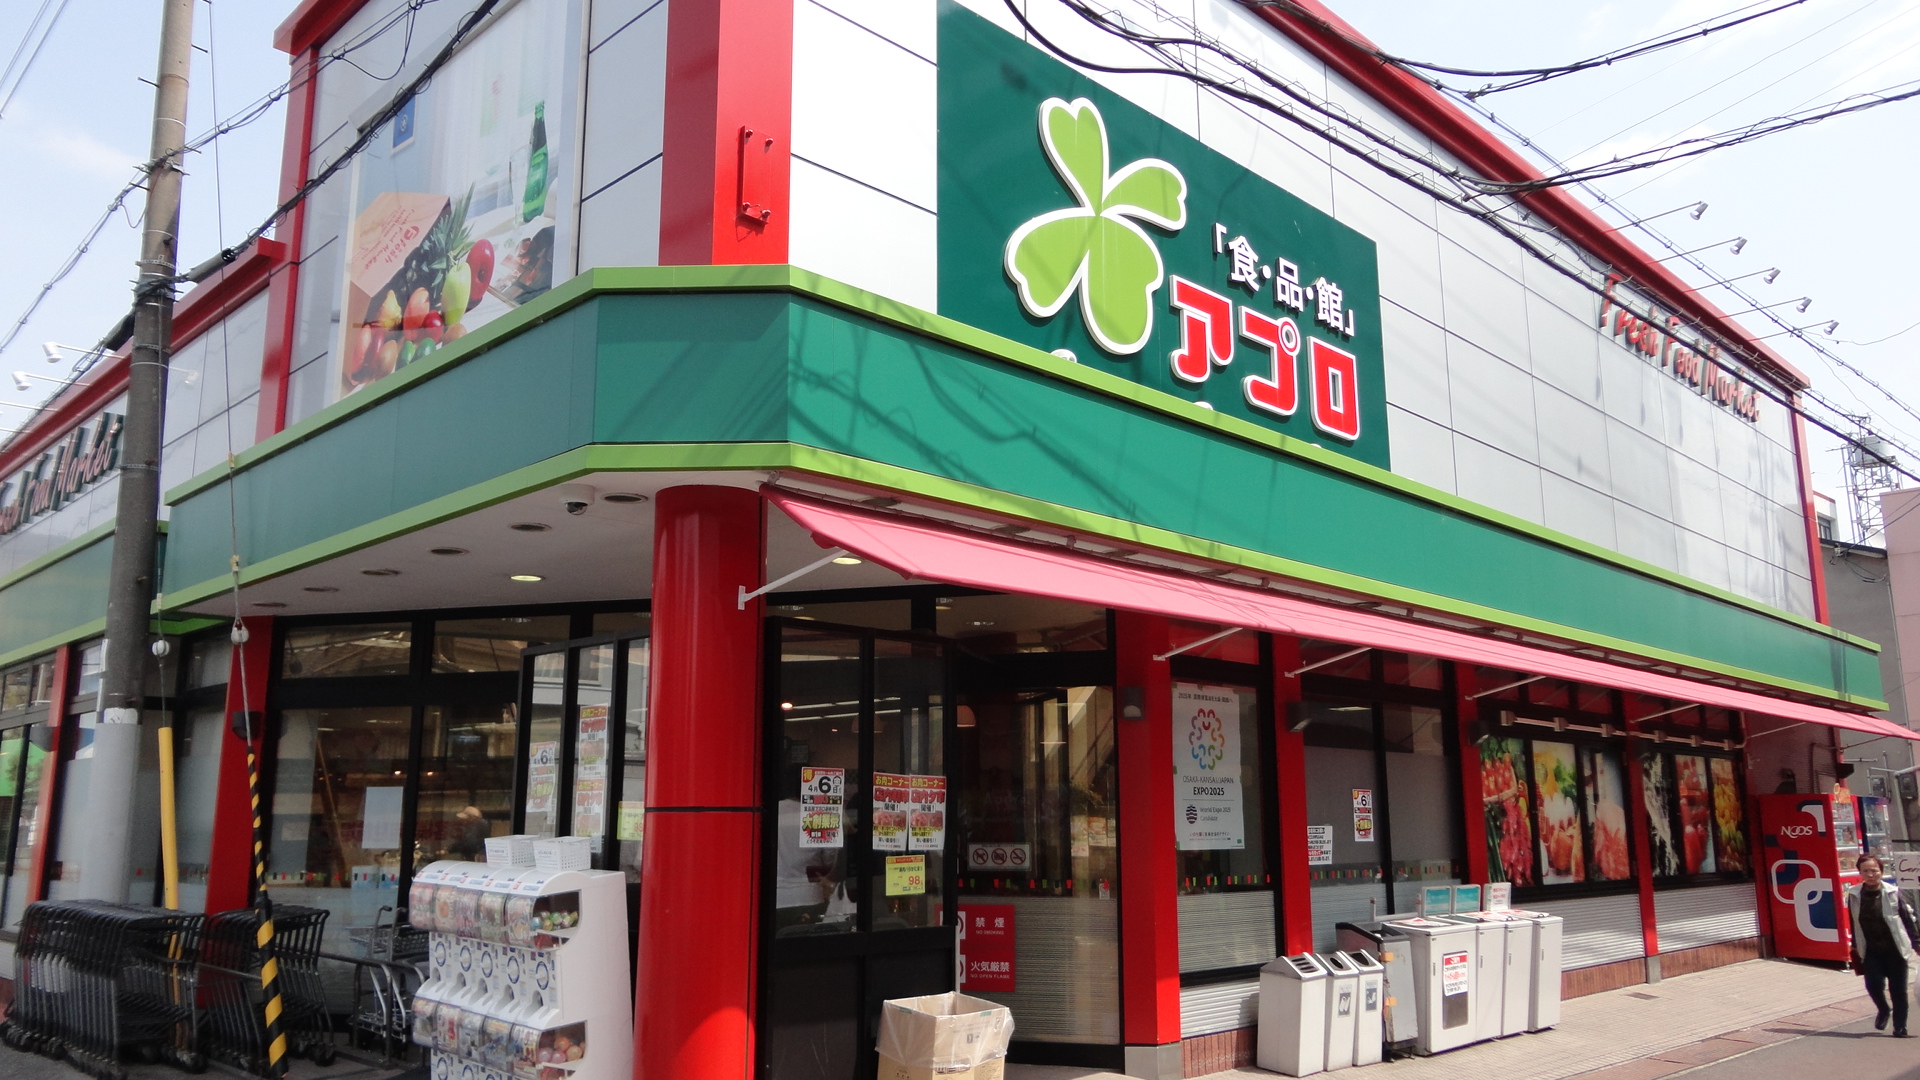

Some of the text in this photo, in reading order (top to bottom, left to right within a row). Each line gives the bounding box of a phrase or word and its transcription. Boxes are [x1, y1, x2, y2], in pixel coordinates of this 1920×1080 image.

[1169, 275, 1361, 441] アプロ
[1600, 272, 1761, 423] Fresh Food Market
[908, 875, 920, 885] 98
[970, 961, 1010, 972] 火気厳禁
